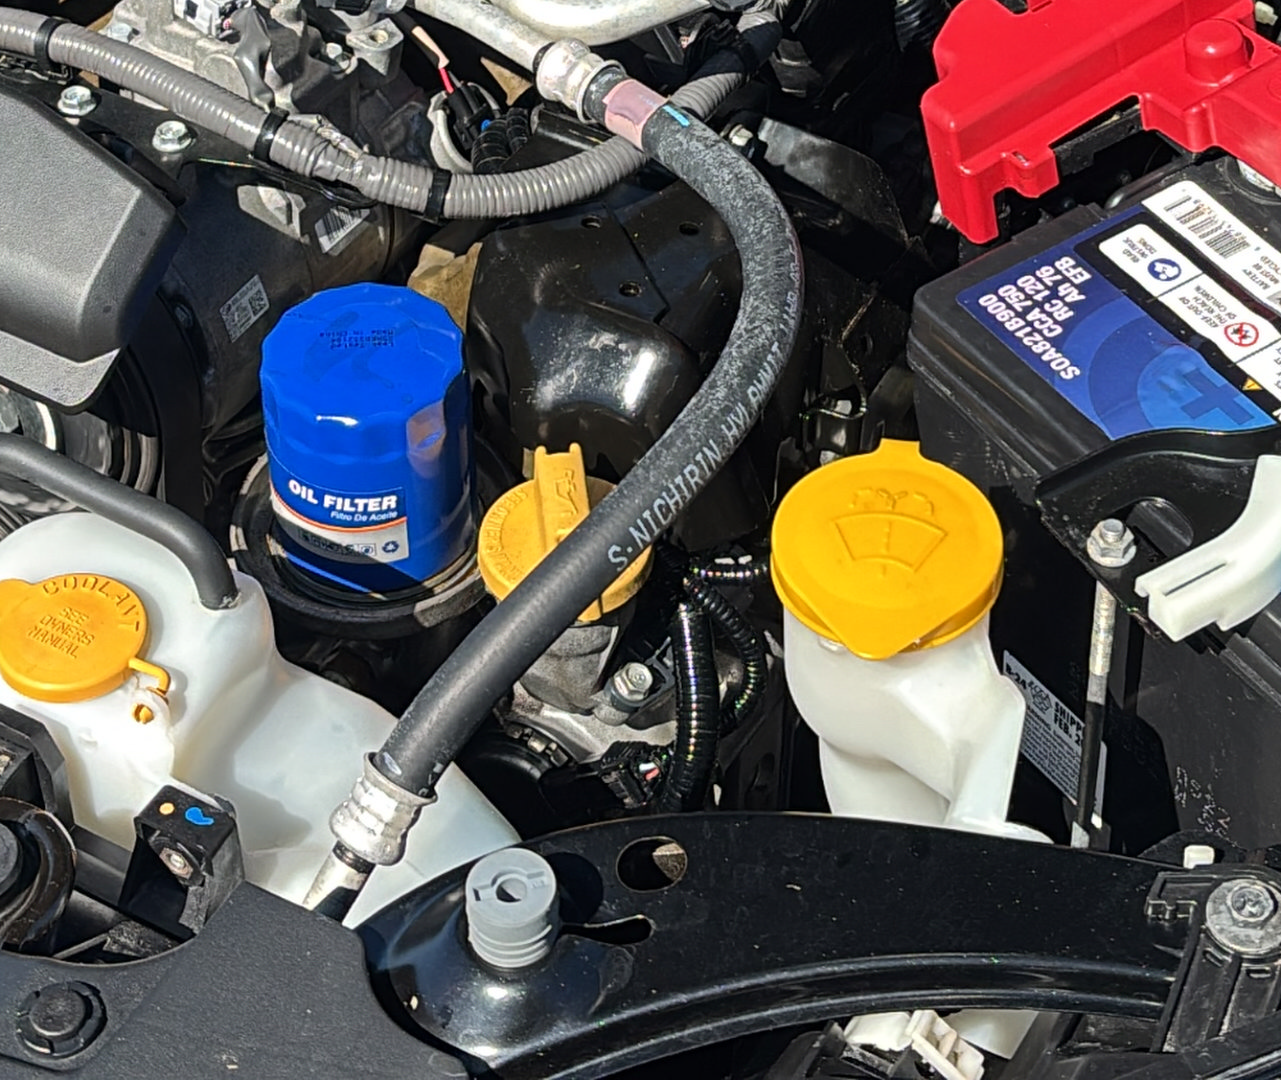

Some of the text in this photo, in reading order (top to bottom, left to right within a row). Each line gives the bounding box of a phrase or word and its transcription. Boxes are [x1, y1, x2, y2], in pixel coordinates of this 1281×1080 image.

[1032, 264, 1086, 305] Ah 76
[1051, 255, 1092, 284] EFB
[995, 282, 1065, 339] CCA 750
[1014, 273, 1075, 322] RC 120
[288, 479, 397, 512] OIL FILTER
[330, 510, 398, 522] Filtro De Aceite
[59, 607, 89, 627] SEE
[27, 626, 79, 659] MANUAL
